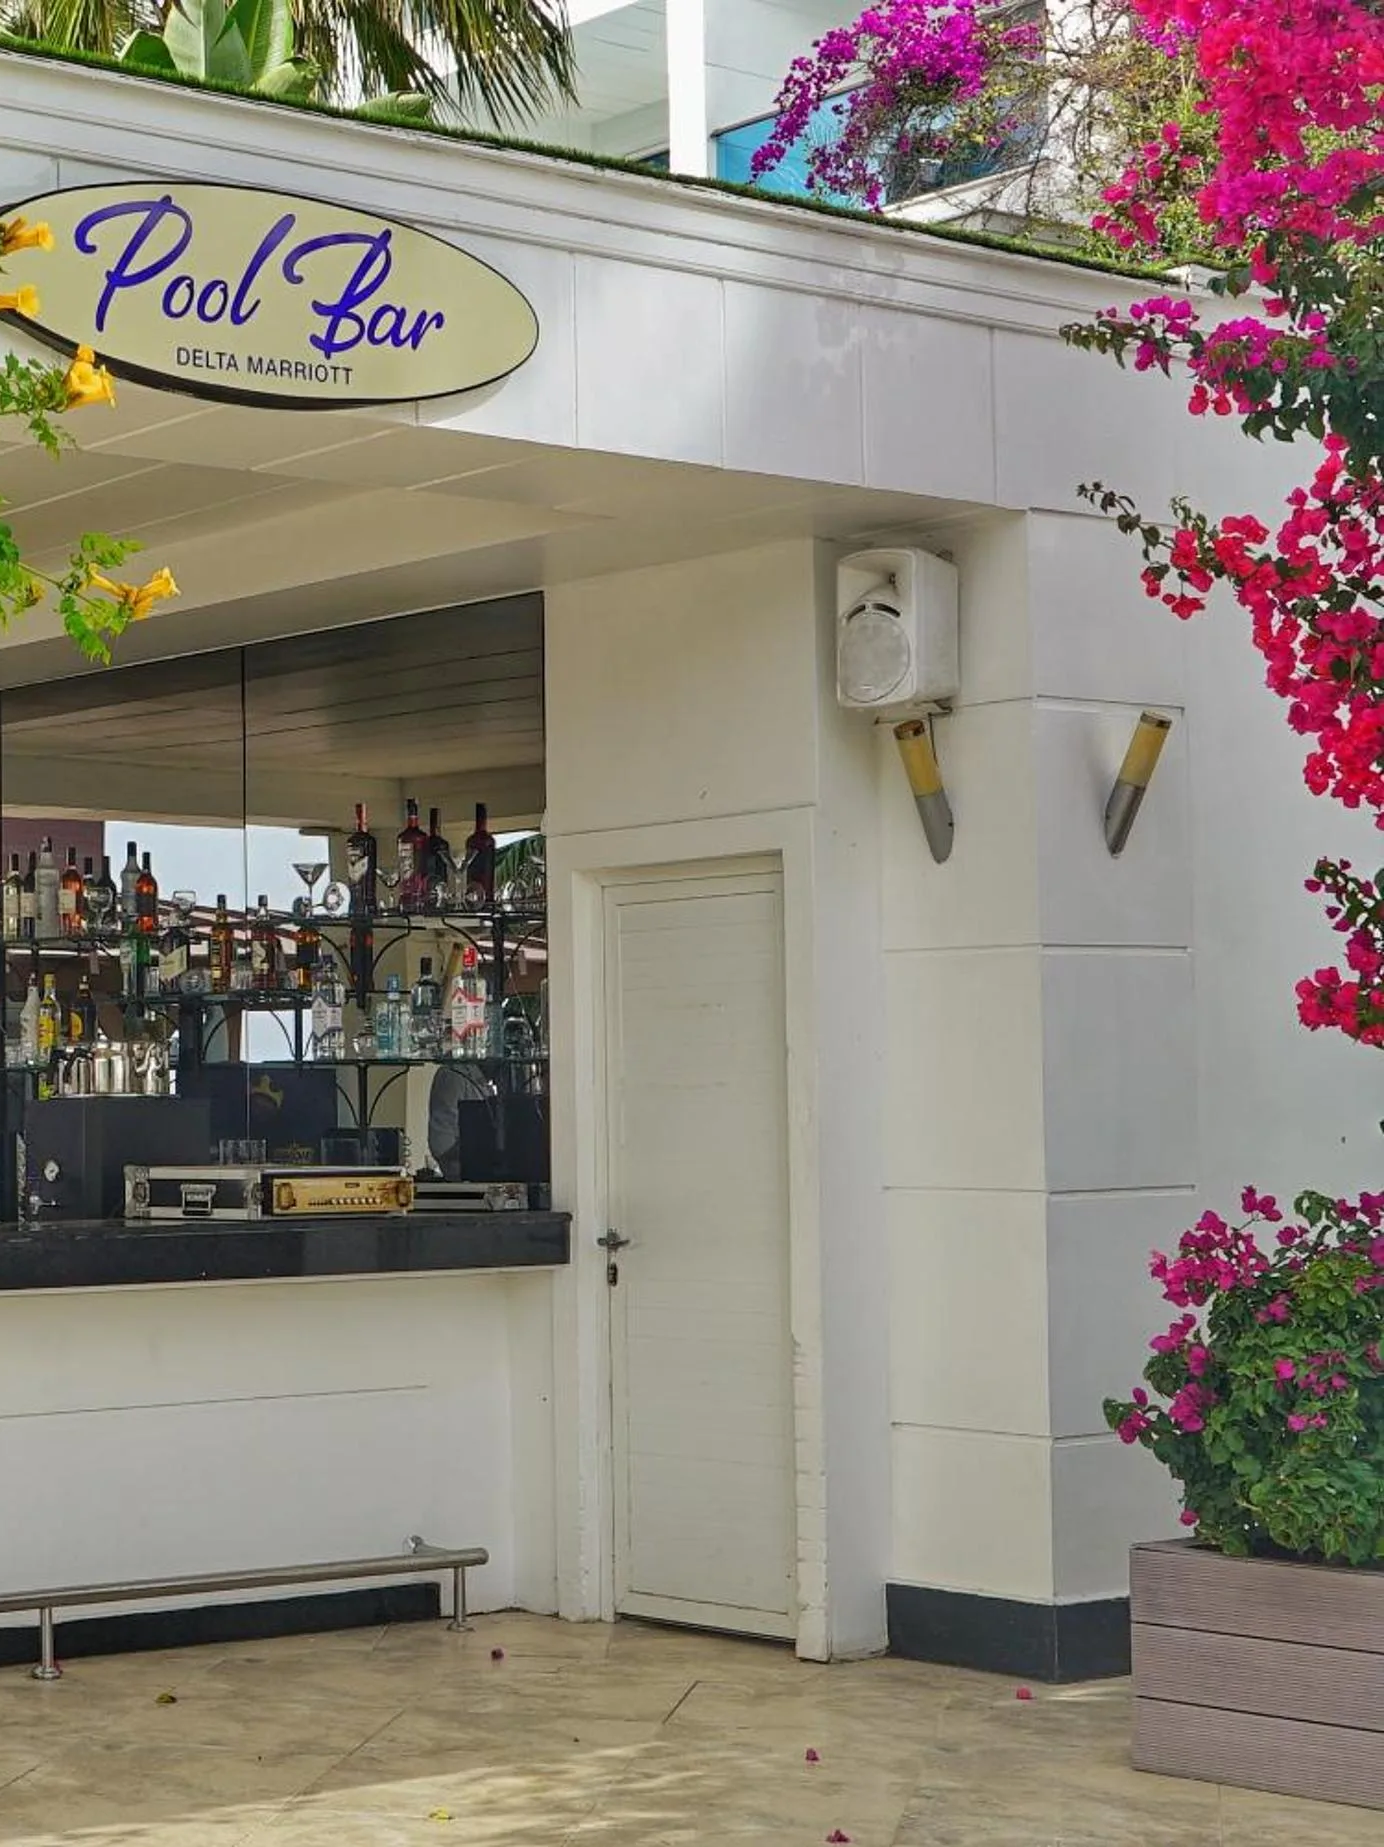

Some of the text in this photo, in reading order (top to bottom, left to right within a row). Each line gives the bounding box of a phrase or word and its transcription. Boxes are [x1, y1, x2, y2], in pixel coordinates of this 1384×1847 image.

[74, 195, 445, 359] Pool Bar
[176, 346, 354, 386] DELTA MARRIOTT
